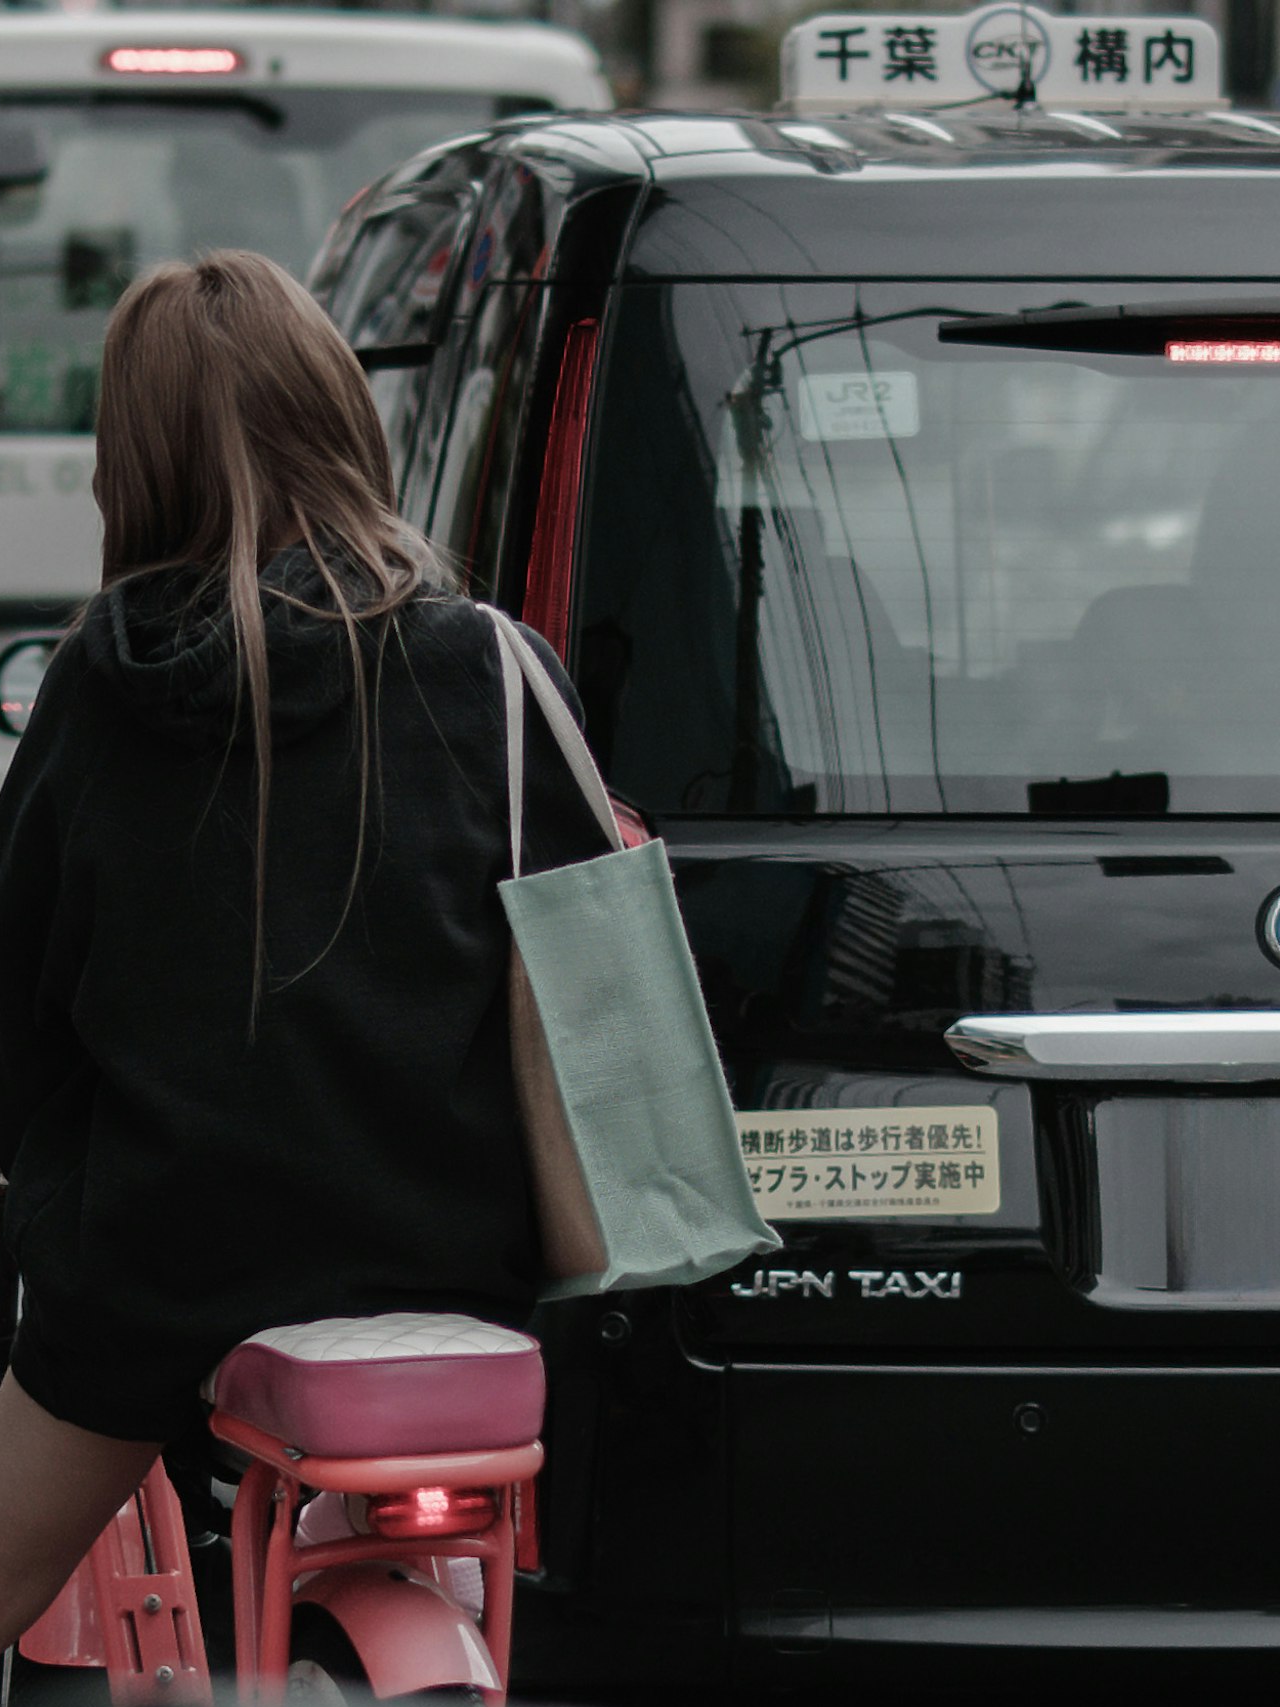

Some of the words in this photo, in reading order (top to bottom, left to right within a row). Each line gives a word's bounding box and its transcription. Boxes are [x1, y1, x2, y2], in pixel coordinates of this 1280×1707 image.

[817, 26, 937, 81] 千葉
[1077, 27, 1195, 83] 構内
[740, 1124, 982, 1154] 横断歩道は歩行者優先!
[731, 1269, 835, 1298] JPN
[848, 1270, 962, 1299] TAXI
